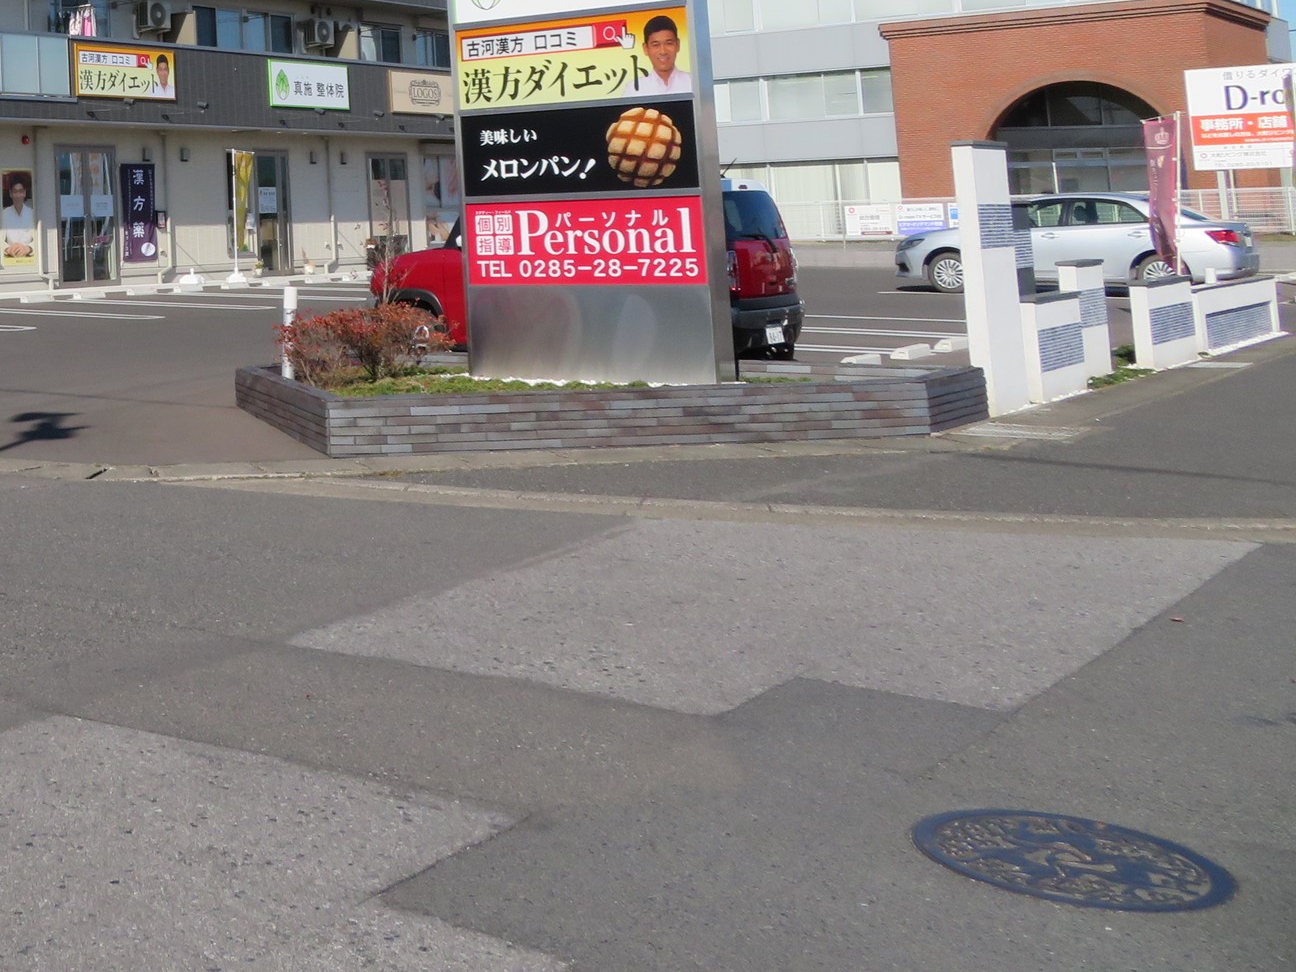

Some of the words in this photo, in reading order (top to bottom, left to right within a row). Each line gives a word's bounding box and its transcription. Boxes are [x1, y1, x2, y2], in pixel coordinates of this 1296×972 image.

[466, 36, 524, 58] 古河漢方
[534, 31, 578, 51] 口コミ
[81, 53, 108, 64] 古河漢方
[112, 55, 131, 65] 口コミ
[79, 69, 159, 94] 漢方ダイエット
[293, 80, 313, 97] 真施
[316, 82, 345, 99] 整体院
[462, 54, 650, 105] 漢方ダイエット
[412, 87, 438, 100] LOGOS
[1200, 114, 1288, 132] 事務所・店舗
[479, 128, 538, 147] 美味しい
[480, 155, 597, 182] メロンパン!
[132, 169, 146, 238] 漢方薬
[555, 209, 669, 228] パーソナル
[514, 206, 697, 256] Personal
[477, 260, 512, 278] TEL
[519, 258, 699, 278] 0285-28-7225
